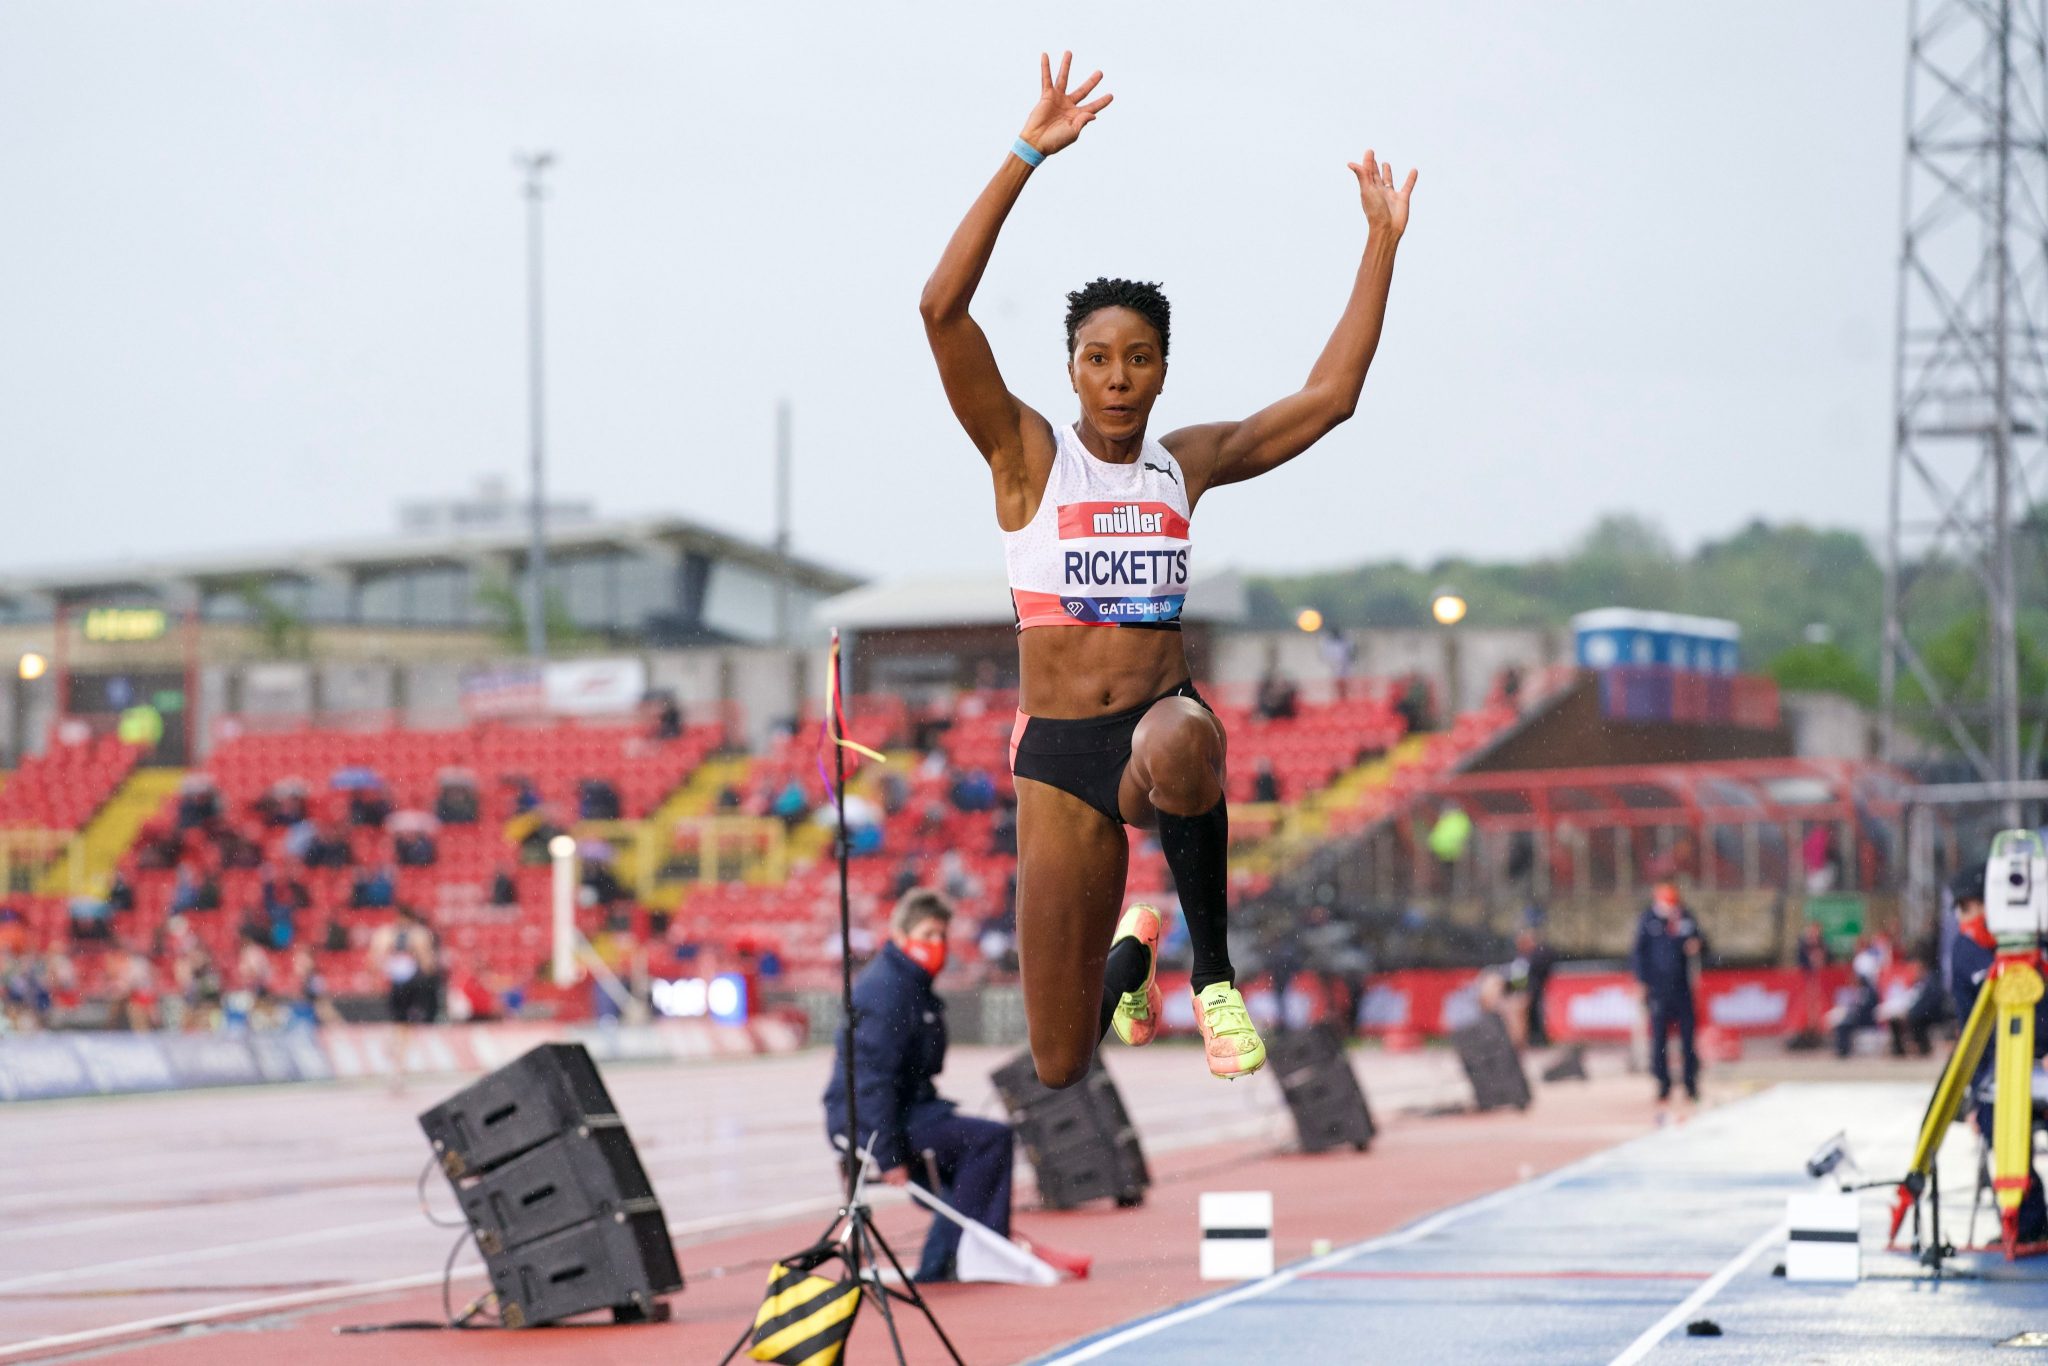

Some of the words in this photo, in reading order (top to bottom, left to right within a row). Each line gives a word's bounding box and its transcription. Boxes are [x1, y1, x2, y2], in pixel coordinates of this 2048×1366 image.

[1093, 505, 1163, 534] müller
[1065, 550, 1187, 585] RICKETTS
[1099, 602, 1171, 615] GATESHEAD
